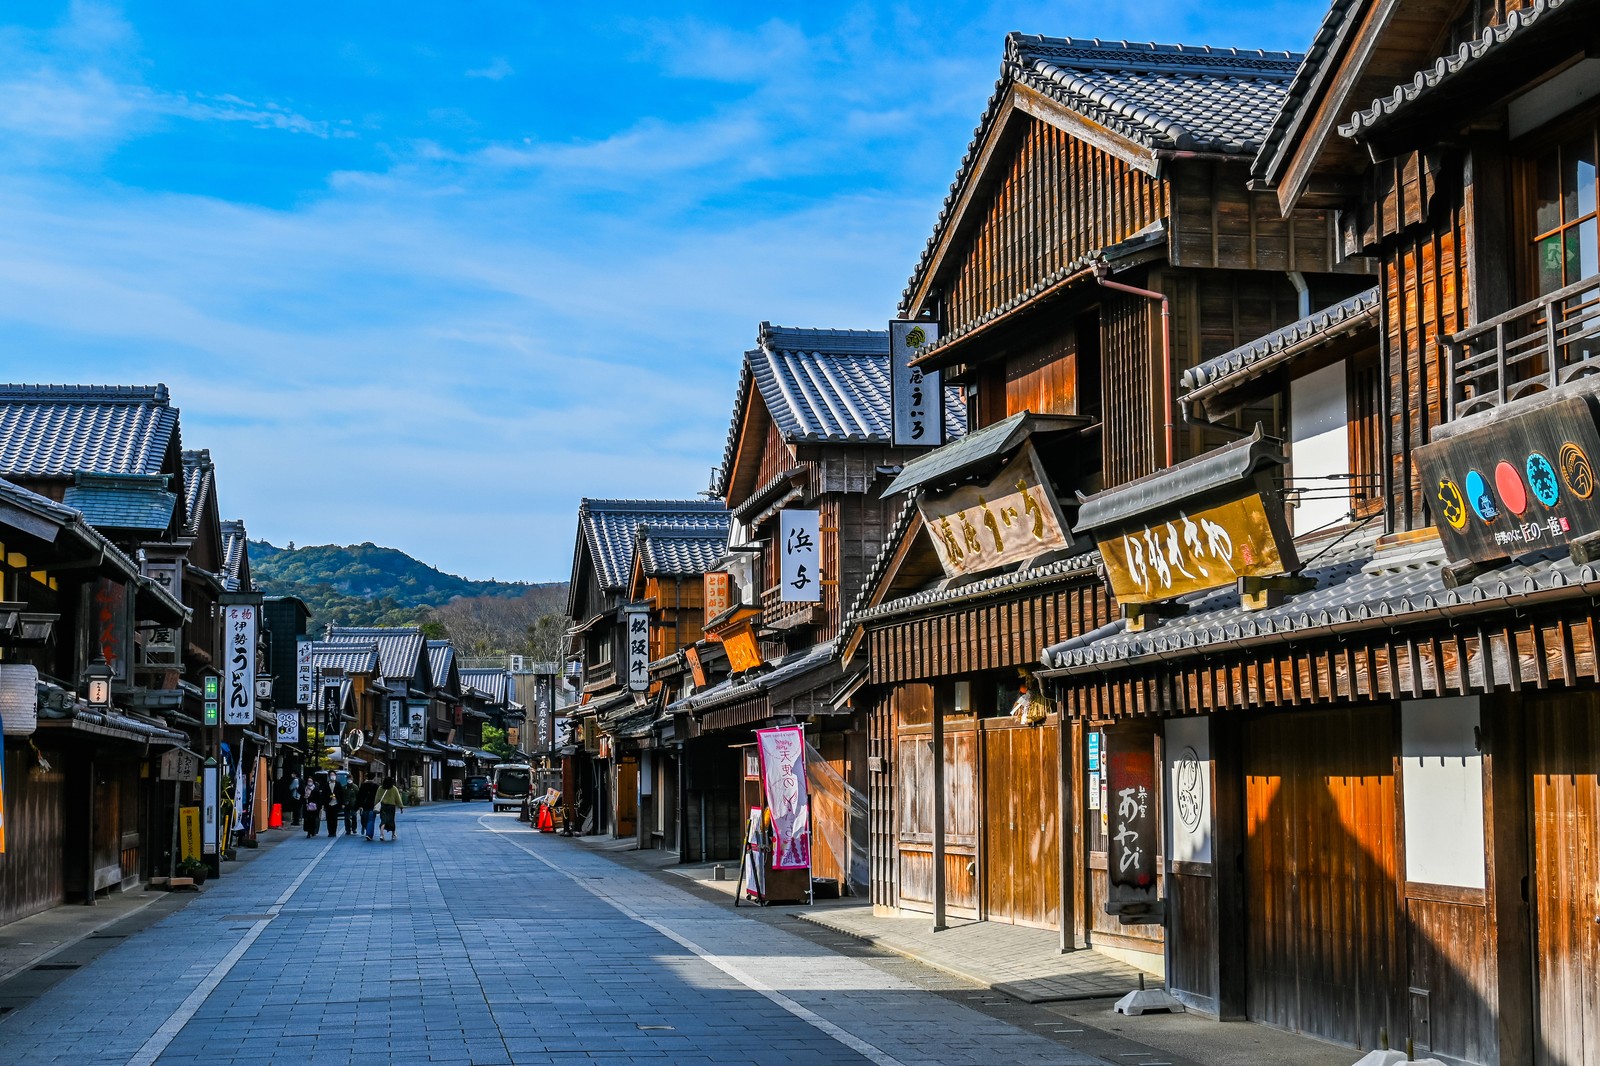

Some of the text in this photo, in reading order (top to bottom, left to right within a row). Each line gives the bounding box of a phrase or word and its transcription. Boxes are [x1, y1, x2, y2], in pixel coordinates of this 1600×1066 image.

[787, 527, 814, 590] 浜与
[228, 609, 252, 620] 名物
[230, 621, 248, 709] 伊勢うどん
[630, 618, 648, 676] 松阪牛
[1113, 787, 1143, 873] あわび
